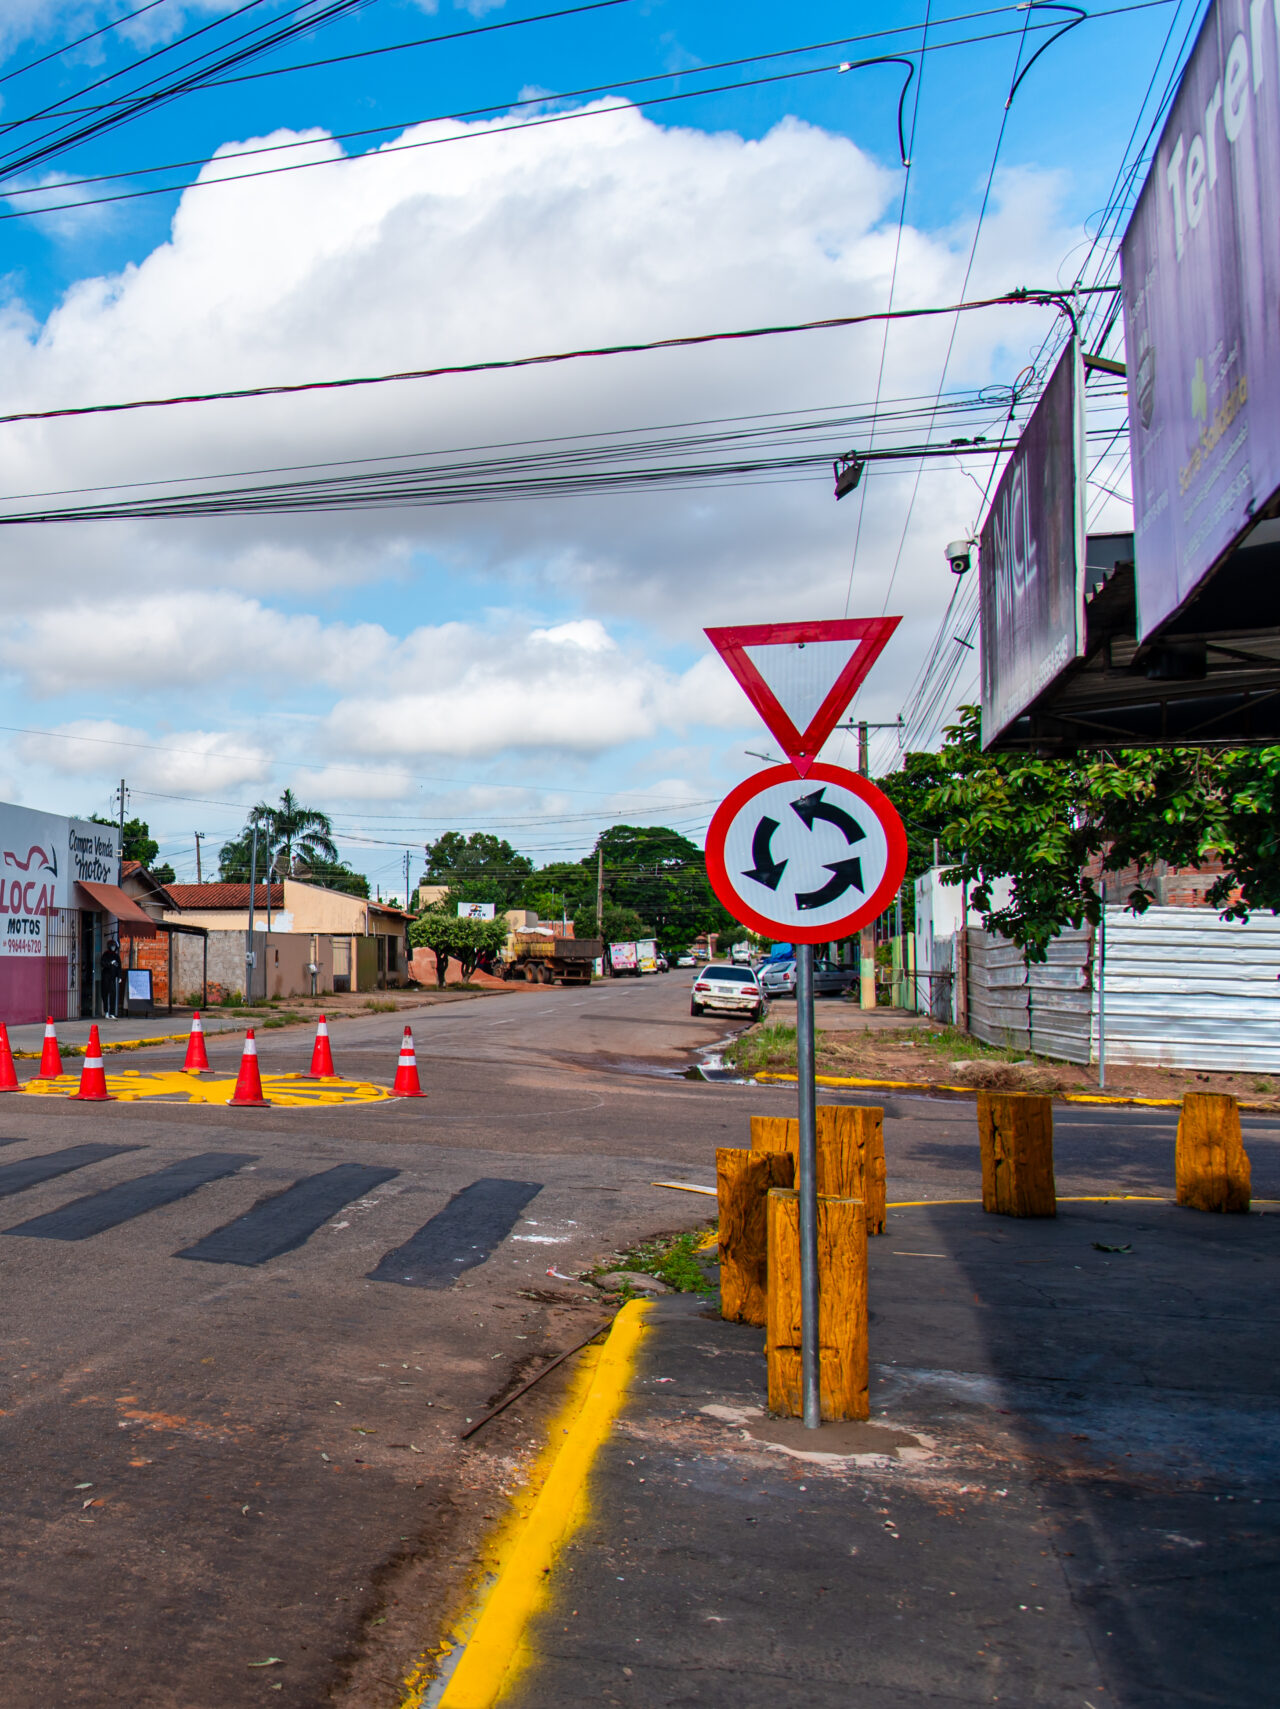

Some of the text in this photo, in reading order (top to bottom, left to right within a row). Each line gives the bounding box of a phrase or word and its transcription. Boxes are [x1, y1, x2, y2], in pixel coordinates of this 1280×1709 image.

[69, 829, 114, 860] Compra Venda
[7, 918, 41, 935] MOTOS
